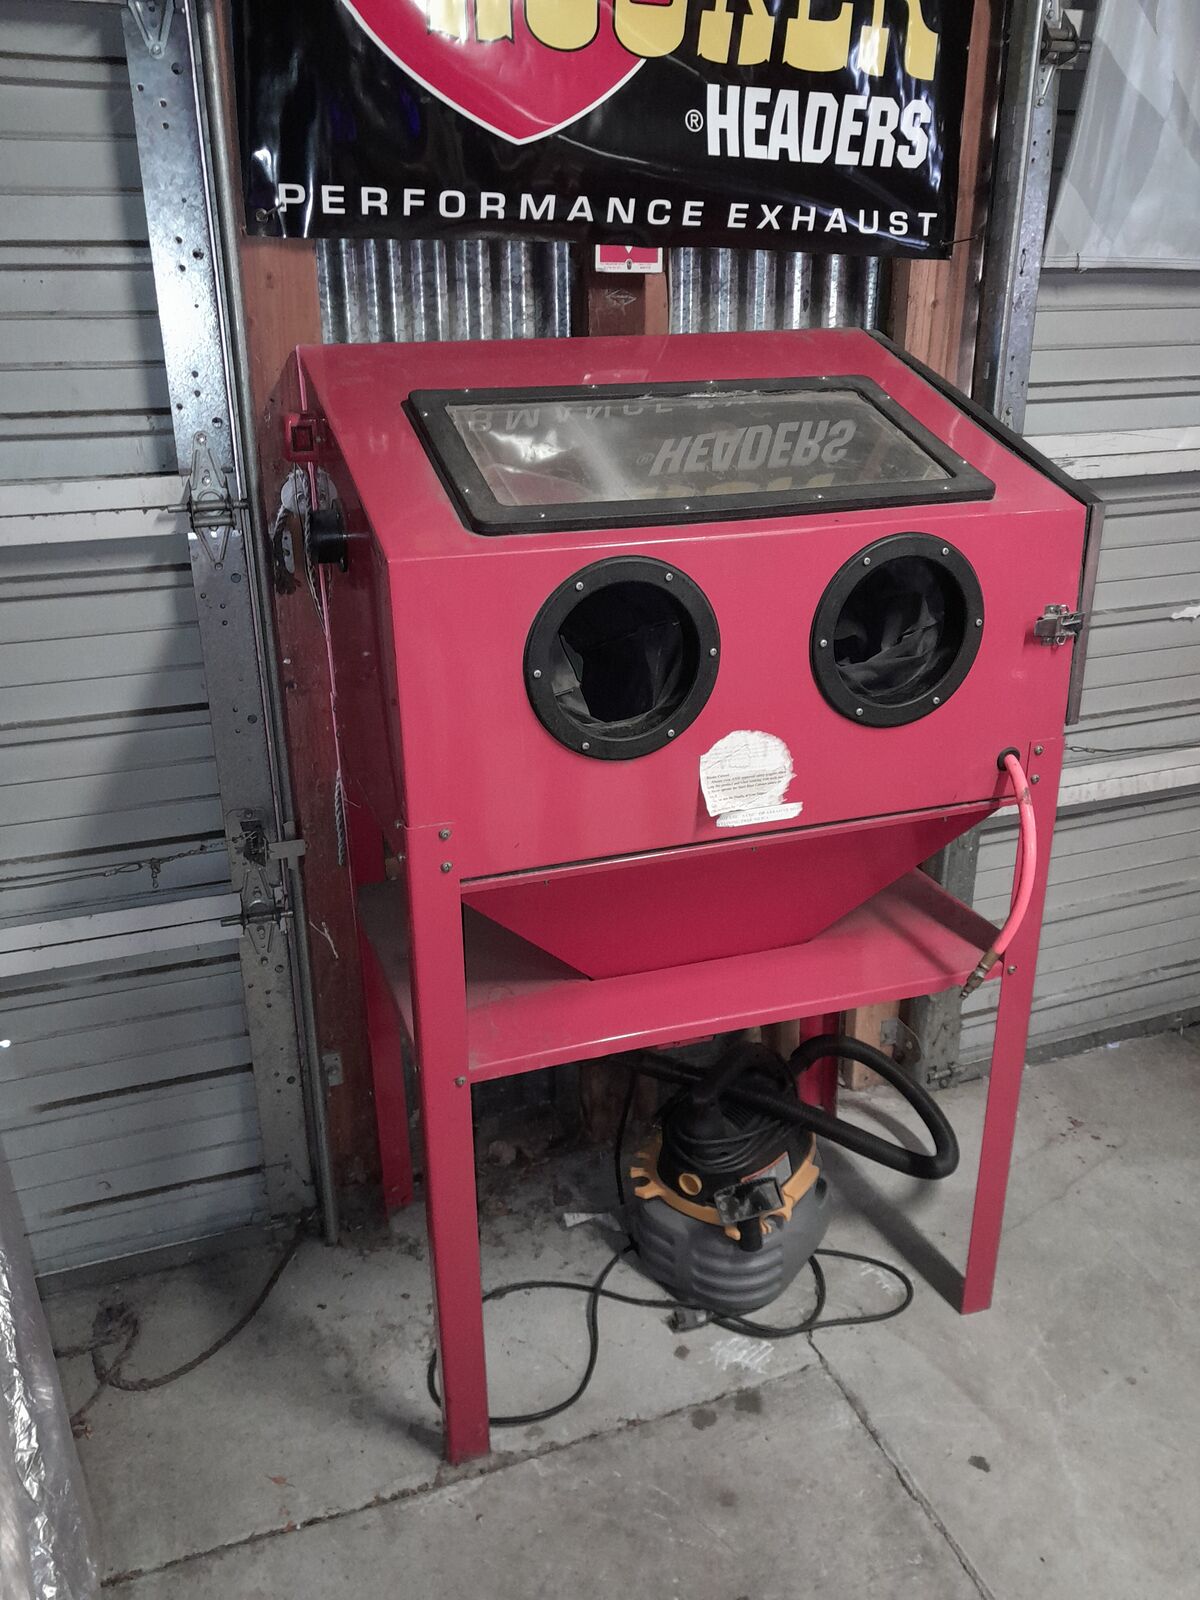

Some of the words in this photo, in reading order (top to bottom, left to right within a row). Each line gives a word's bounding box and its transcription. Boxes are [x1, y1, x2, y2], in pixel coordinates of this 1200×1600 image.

[706, 83, 932, 169] HEADERS
[277, 182, 705, 227] PERFORMANCE
[727, 202, 938, 237] EXHAUST
